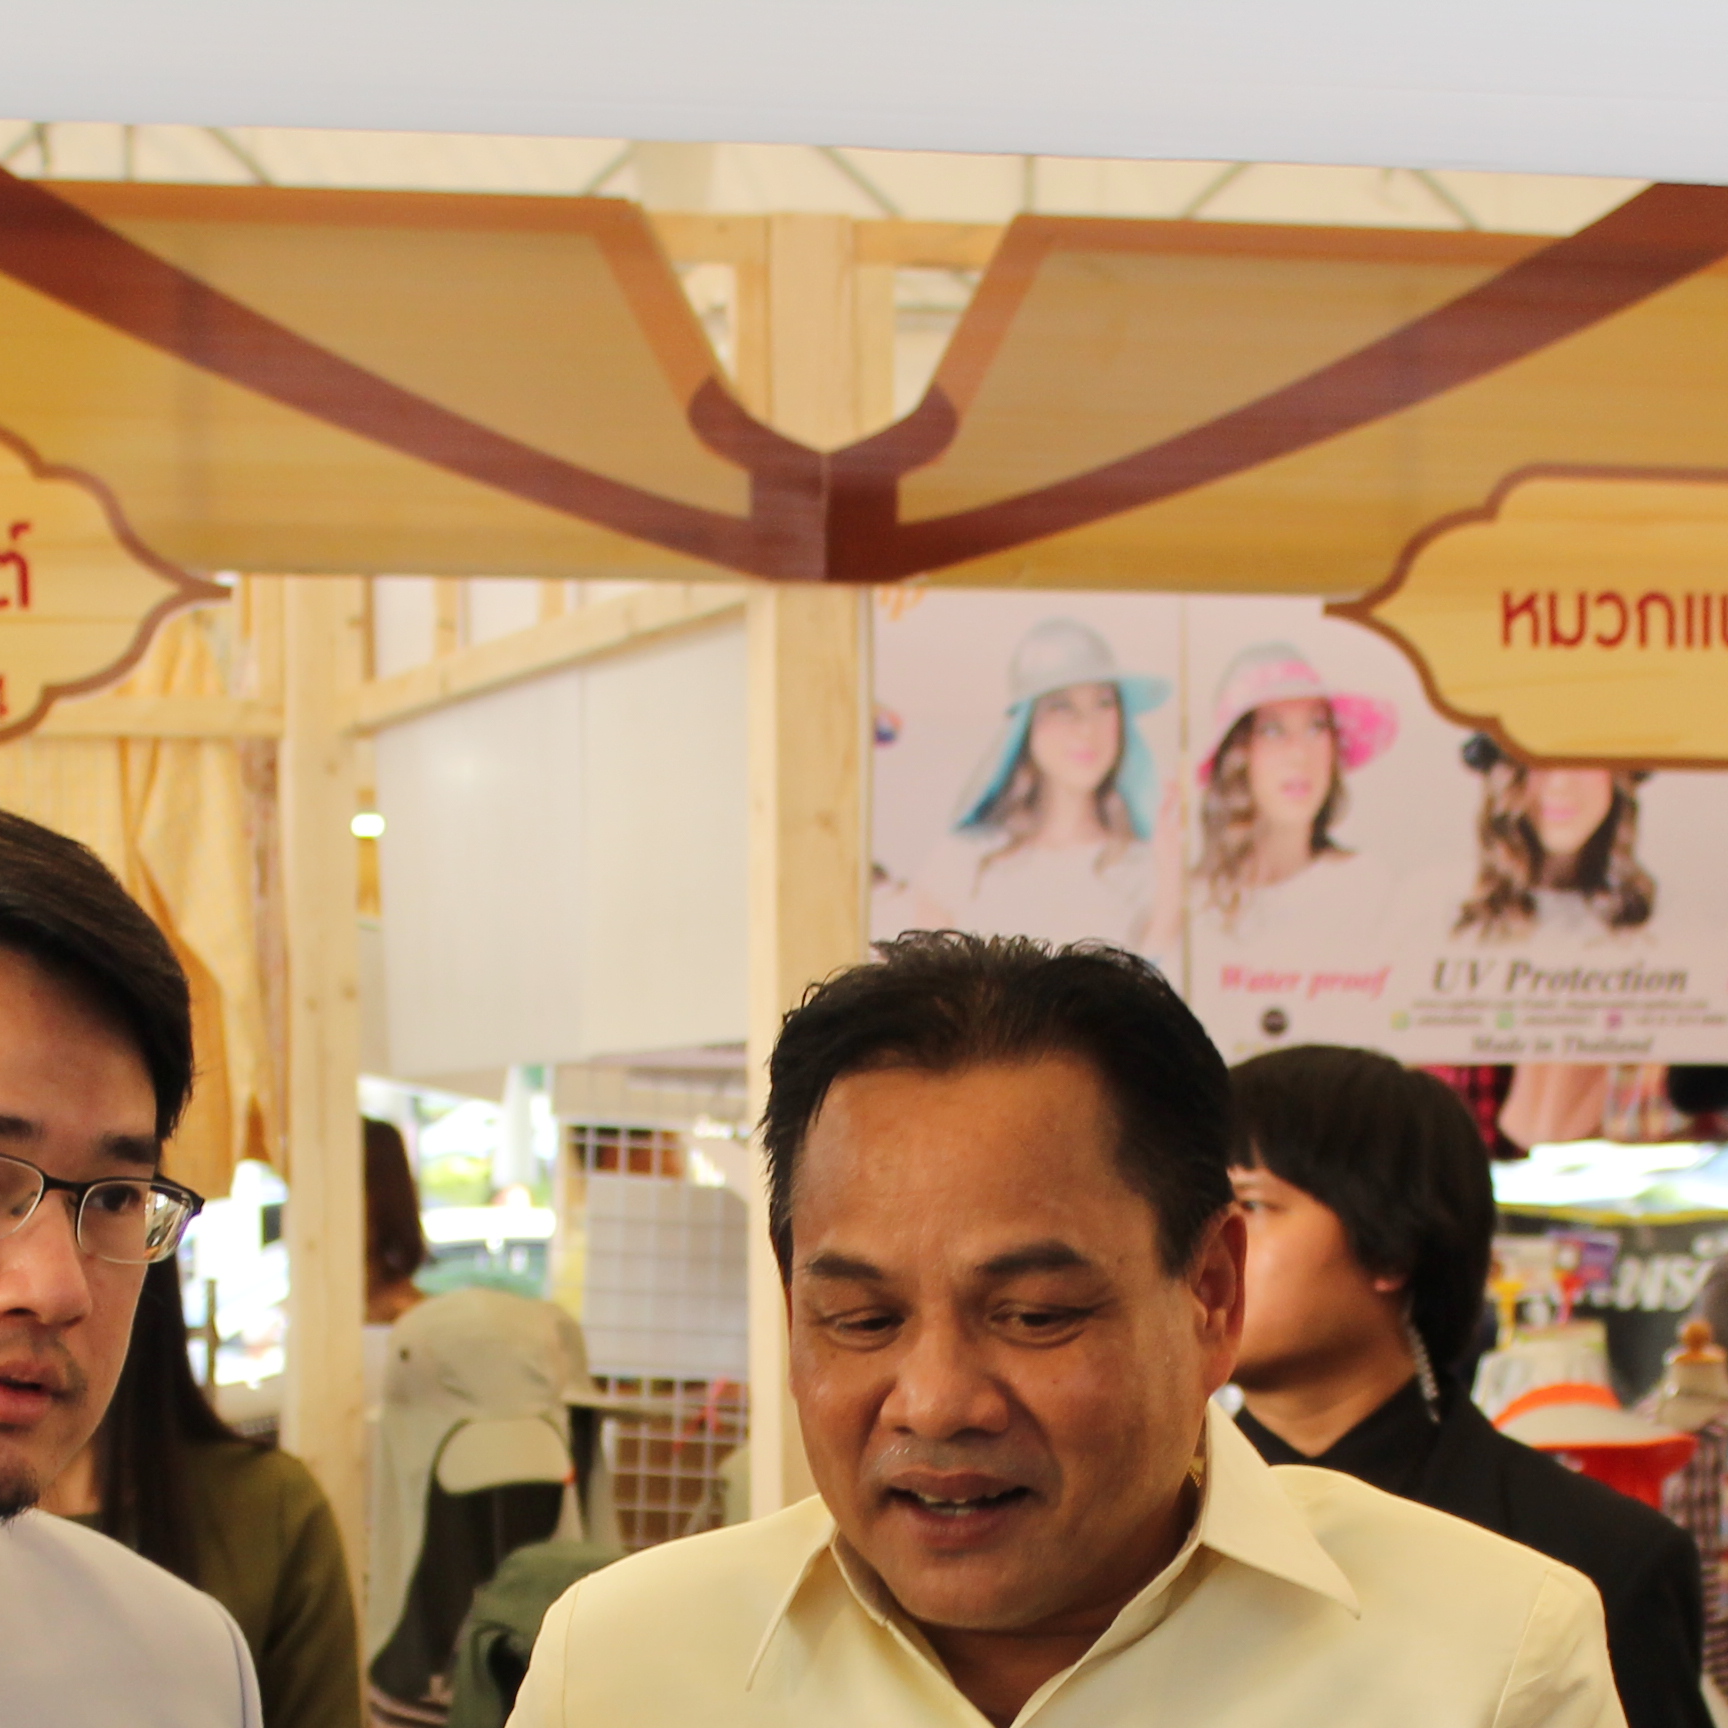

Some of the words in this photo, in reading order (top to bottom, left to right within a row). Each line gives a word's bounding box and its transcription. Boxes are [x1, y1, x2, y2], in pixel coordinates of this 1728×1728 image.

[1305, 964, 1392, 1000] proof
[1432, 957, 1494, 993] UV
[1504, 957, 1688, 993] Protection
